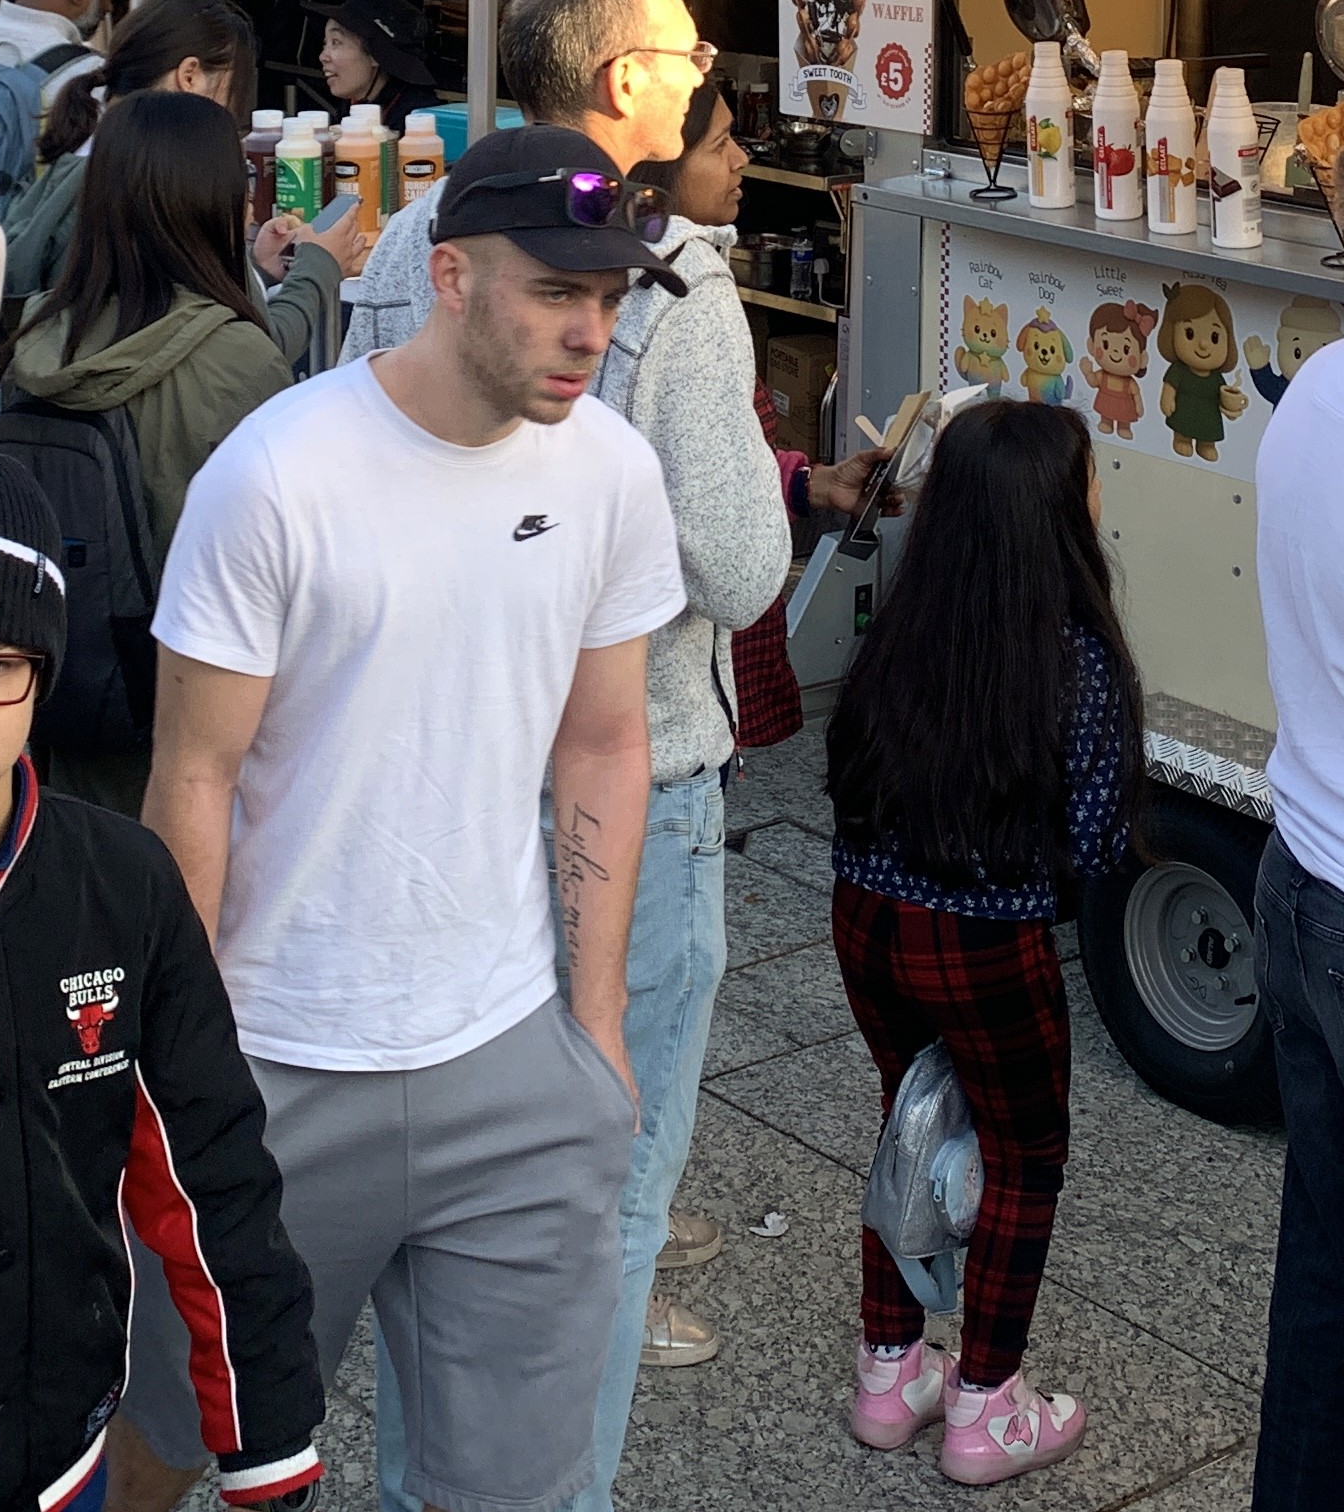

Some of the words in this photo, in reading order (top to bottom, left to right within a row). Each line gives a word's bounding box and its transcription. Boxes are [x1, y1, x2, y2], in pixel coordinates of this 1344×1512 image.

[872, 3, 924, 22] WAFFLE
[803, 68, 827, 79] SWEET
[829, 69, 853, 84] TOOTH
[880, 61, 903, 92] £5
[969, 261, 1004, 280] Rainbow
[1093, 265, 1127, 283] Little
[978, 275, 994, 290] Cat
[1028, 271, 1066, 292] Rainbow
[1096, 283, 1124, 299] Sweet
[1038, 286, 1055, 304] Dog
[59, 967, 125, 994] CHICAGO
[68, 984, 114, 1007] BULLS
